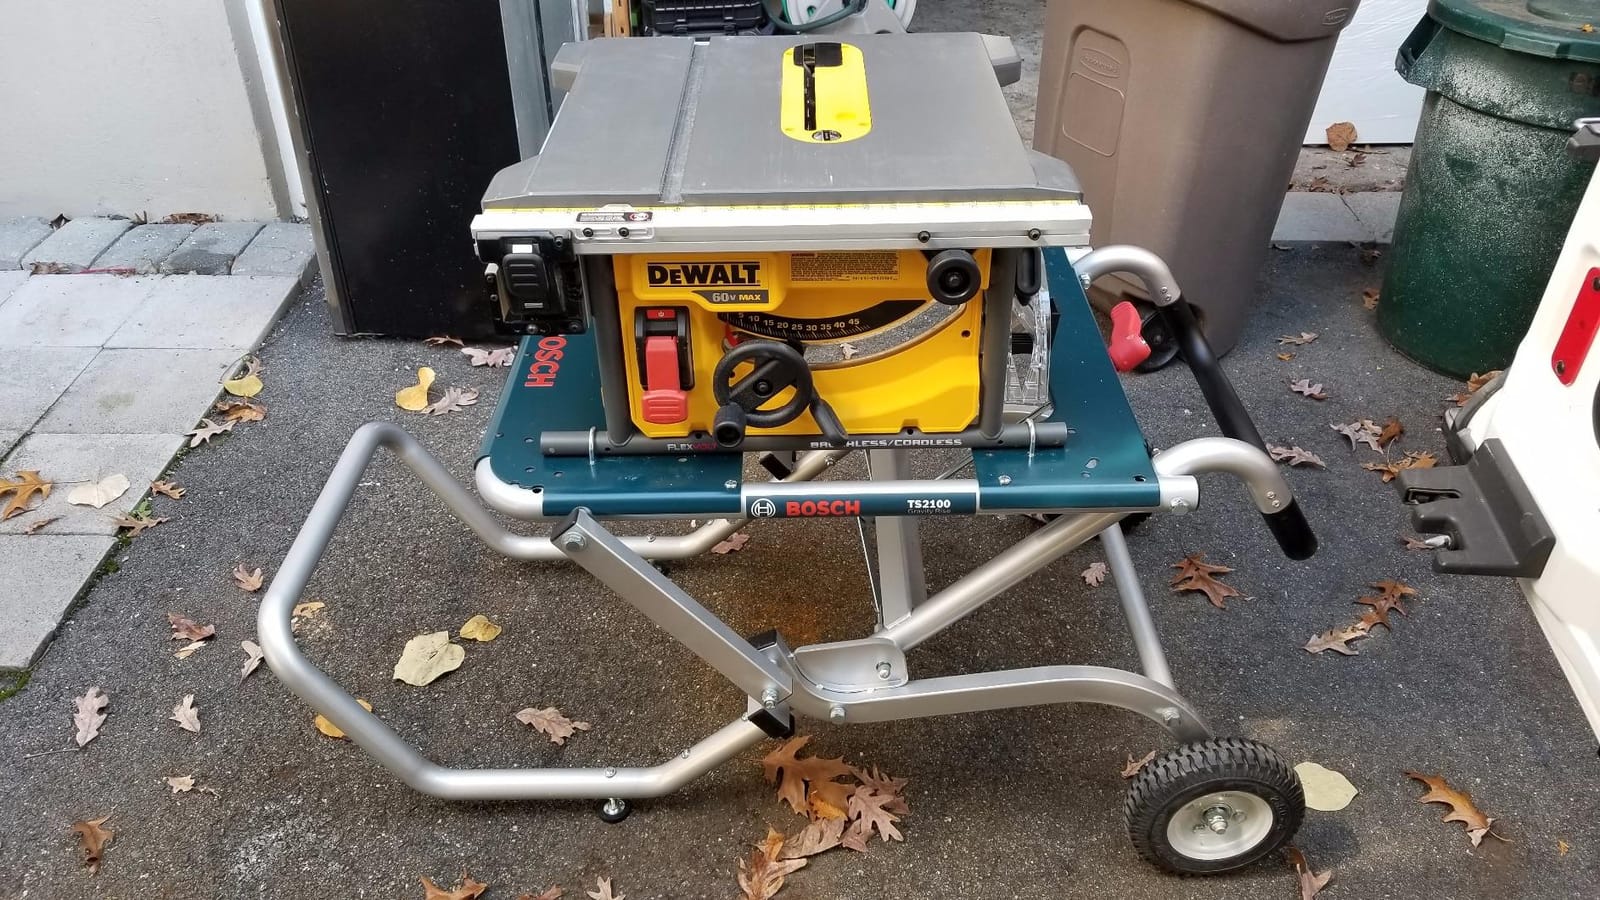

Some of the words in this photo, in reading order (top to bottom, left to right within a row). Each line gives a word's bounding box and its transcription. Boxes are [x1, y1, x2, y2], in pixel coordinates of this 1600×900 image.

[739, 293, 761, 302] MAX
[791, 323, 803, 331] 25
[806, 324, 818, 332] 30
[820, 323, 832, 331] 35
[834, 321, 846, 329] 40
[849, 318, 860, 326] 45
[524, 335, 567, 387] OSCH
[786, 500, 860, 516] BOSCH
[907, 499, 952, 509] TS2100
